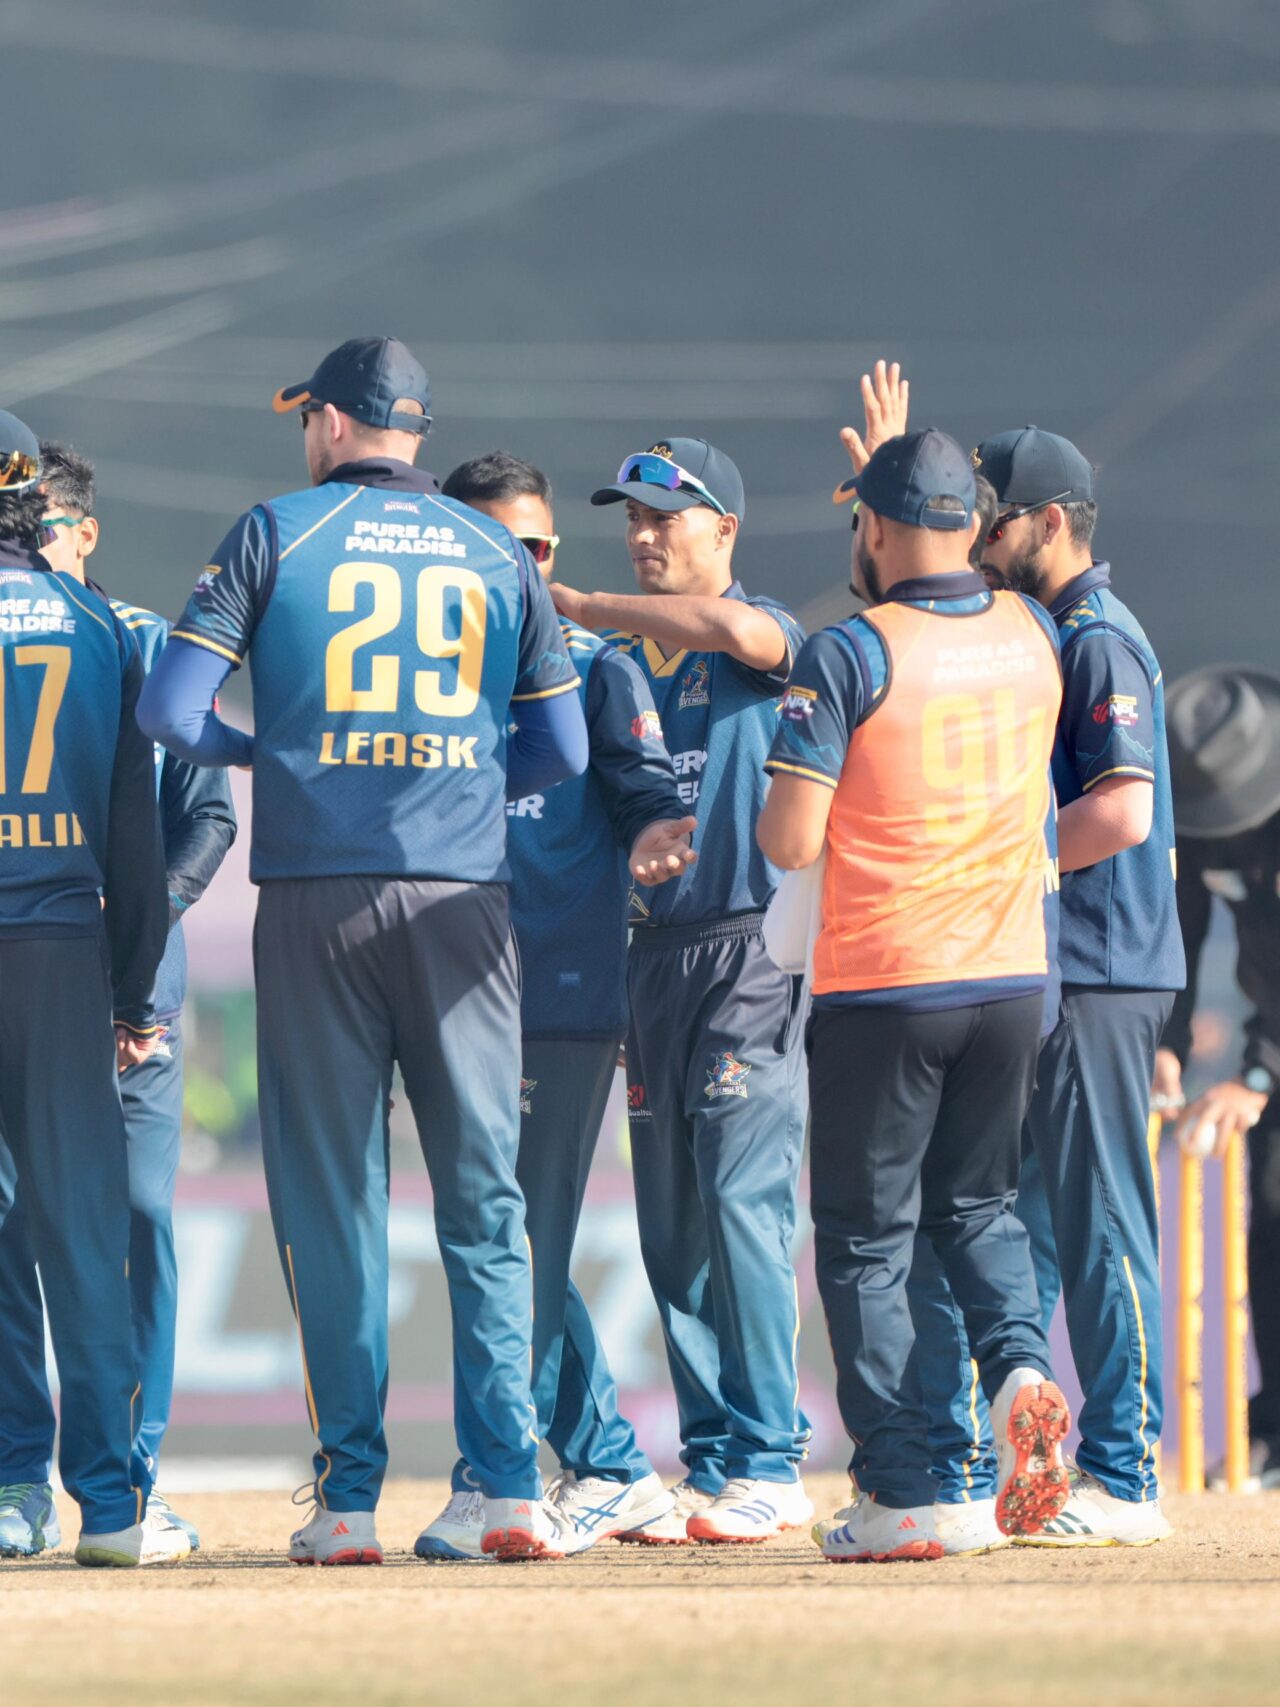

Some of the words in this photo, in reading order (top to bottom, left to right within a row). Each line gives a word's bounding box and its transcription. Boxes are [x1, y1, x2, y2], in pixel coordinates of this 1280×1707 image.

[354, 520, 420, 538] PURE
[422, 526, 455, 541] AS
[345, 536, 467, 558] PARADISE
[31, 598, 66, 617] AS
[325, 561, 487, 717] 29
[933, 655, 1036, 684] PARADISE
[784, 694, 814, 714] NPL
[1109, 702, 1138, 718] NPL
[318, 732, 478, 769] LEASK
